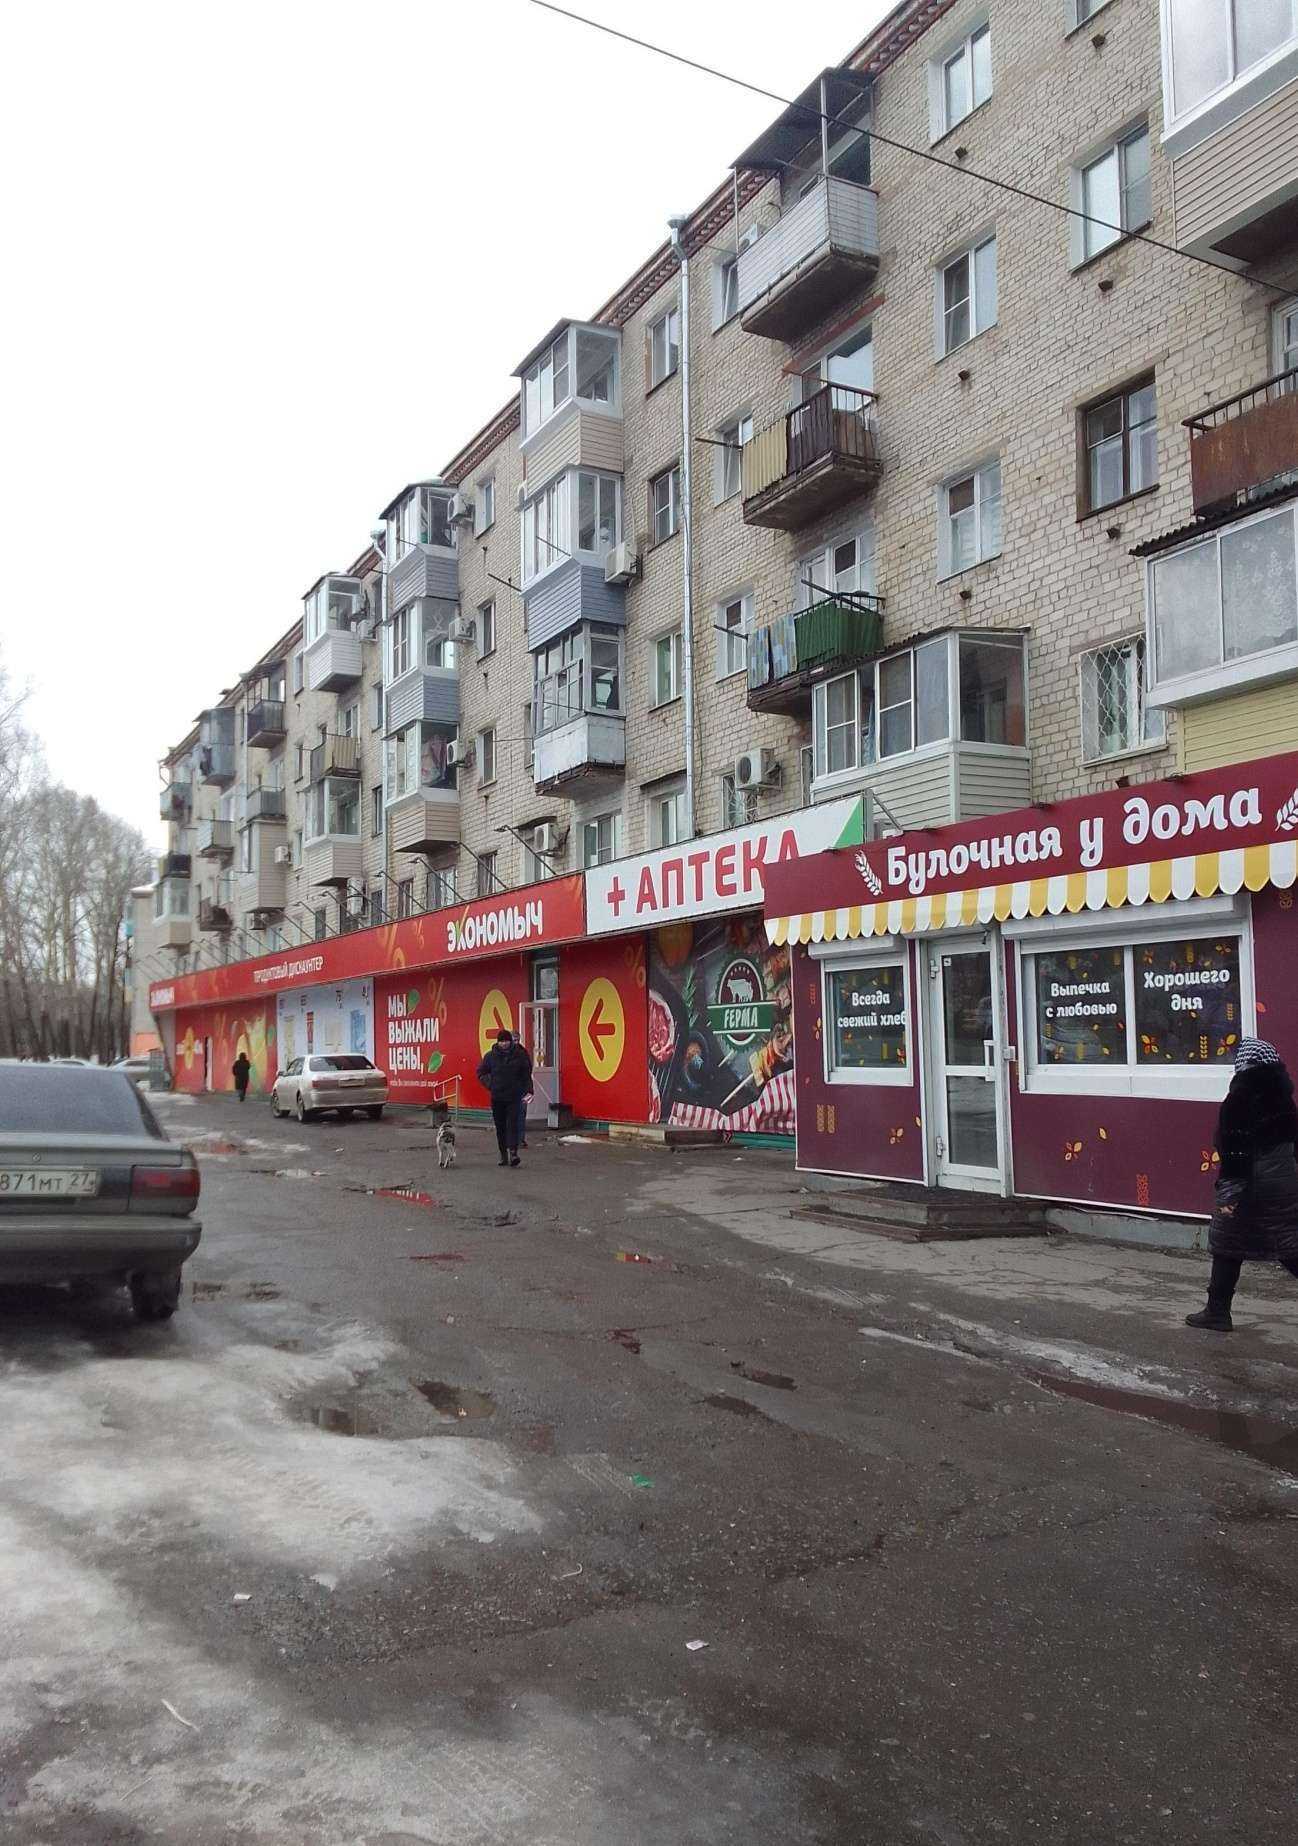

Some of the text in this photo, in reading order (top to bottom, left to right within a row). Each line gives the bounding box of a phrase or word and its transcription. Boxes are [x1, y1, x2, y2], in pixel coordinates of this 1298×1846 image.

[887, 787, 1263, 895] Булочная у дома
[636, 829, 800, 914] АПТЕКА
[447, 900, 543, 952] ЭКОНОМЫЧ
[1050, 981, 1111, 997] Выпечка
[1143, 968, 1231, 992] Хорошего
[387, 993, 407, 1018] МЫ
[851, 990, 891, 1006] Всегда
[1045, 1002, 1118, 1018] с любовью
[1170, 993, 1204, 1011] дня
[388, 1017, 440, 1044] ВЫЖАЛИ
[837, 1010, 907, 1027] свежий хлеб
